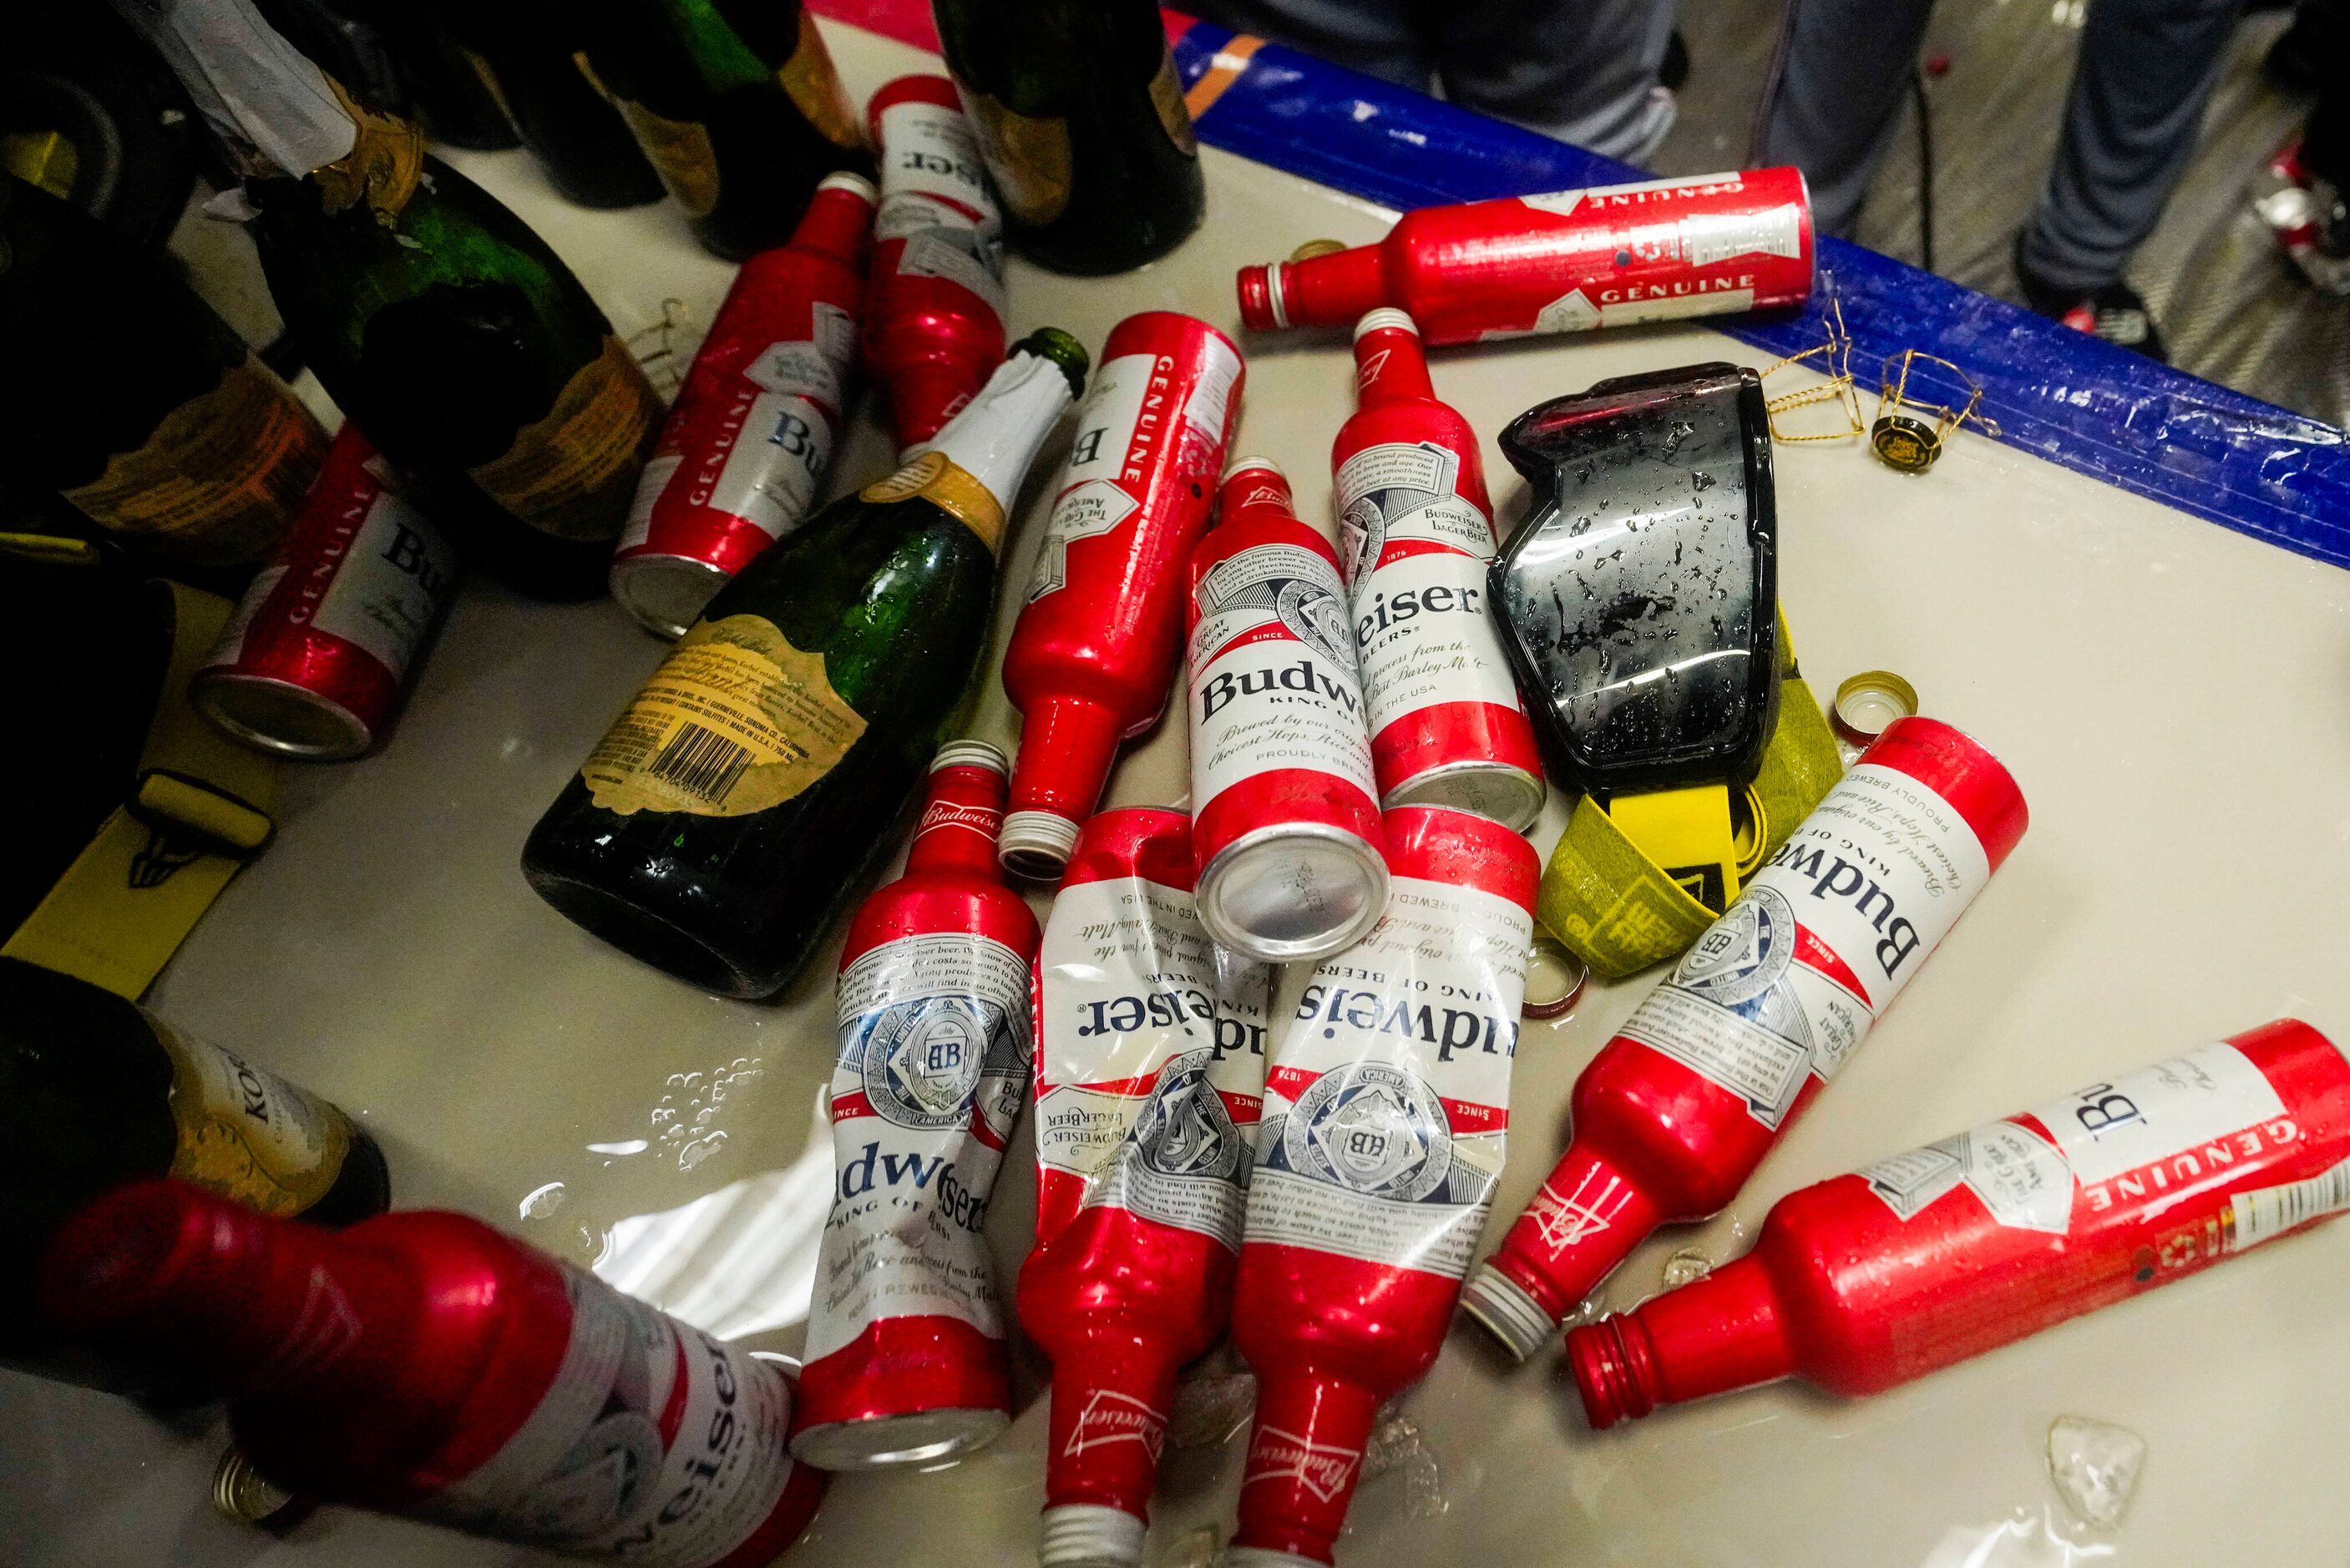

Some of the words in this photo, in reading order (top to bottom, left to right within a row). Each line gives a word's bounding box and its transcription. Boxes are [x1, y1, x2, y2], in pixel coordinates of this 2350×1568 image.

[1590, 182, 1745, 210] GENUINE
[1601, 274, 1755, 302] GENUINE
[1123, 356, 1174, 483] GENUINE
[690, 390, 752, 506] GENUINE
[1373, 453, 1396, 461] brand
[1397, 453, 1434, 464] produced
[1382, 458, 1398, 467] and
[1417, 462, 1433, 470] Our
[1383, 467, 1431, 478] smoothness
[1425, 508, 1484, 529] BUDWEISER
[1213, 568, 1228, 581] This
[1237, 556, 1250, 565] the
[1251, 550, 1283, 559] famous
[1386, 550, 1407, 563] 1876
[1217, 577, 1227, 586] by
[1228, 567, 1243, 578] any
[1244, 558, 1266, 569] other
[1220, 568, 1256, 590] exclusive
[1258, 562, 1307, 570] Beechwood
[1223, 582, 1237, 595] and
[1245, 568, 1297, 582] drinkability
[1197, 619, 1225, 648] GREAT
[1252, 631, 1284, 641] SINCE
[1410, 645, 1445, 665] from
[1392, 658, 1442, 685] Barley
[1269, 695, 1327, 709] KING
[1386, 693, 1407, 711] THE
[1411, 684, 1437, 698] USA
[678, 700, 702, 714] CONTAINS
[701, 708, 727, 724] SULFITES
[729, 721, 747, 734] MADE
[746, 729, 754, 738] IN
[752, 734, 771, 748] U.S.A.
[774, 745, 786, 757] 750
[744, 716, 770, 735] SONOMA
[778, 736, 810, 761] CALIFORNIA
[1216, 714, 1279, 747] Brewed
[1284, 714, 1302, 726] by
[1306, 720, 1329, 729] our
[1208, 735, 1262, 771] Choicest
[1256, 749, 1326, 761] PROUDLY
[1845, 773, 1892, 790] BREWED
[922, 807, 1002, 832] Budweiser
[1892, 787, 1952, 833] PROUDLY
[1808, 828, 1833, 841] OF
[1840, 838, 1892, 878] KING
[1923, 837, 1963, 896] Choicest
[1897, 843, 1946, 899] Brewed
[1147, 895, 1163, 910] THE
[1165, 904, 1176, 918] IN
[1075, 921, 1121, 939] Malt
[1180, 932, 1201, 947] and
[1094, 947, 1117, 963] the
[1806, 935, 1836, 964] SINCE
[853, 960, 884, 978] famous
[937, 945, 961, 954] beer.
[1002, 957, 1012, 969] of
[932, 957, 959, 966] costs
[1000, 969, 1011, 979] to
[1316, 965, 1386, 984] BEERS
[936, 978, 958, 987] find
[985, 984, 1009, 1000] other
[927, 1042, 961, 1070] AB
[1278, 1070, 1302, 1082] 1876
[1363, 1070, 1403, 1085] AMERICA
[916, 1113, 960, 1125] AMERICA
[1047, 1112, 1080, 1126] BEER
[1456, 1104, 1490, 1120] SINCE
[2072, 1083, 2148, 1143] Bu
[1053, 1127, 1127, 1144] BUDWEISER
[2084, 1119, 2300, 1213] GENUINE
[1167, 1181, 1187, 1190] find
[1189, 1183, 1207, 1192] will
[1172, 1201, 1197, 1209] costs
[1185, 1191, 1213, 1202] Aging
[837, 1201, 879, 1230] KING
[1199, 1202, 1223, 1214] which
[970, 1266, 986, 1280] the
